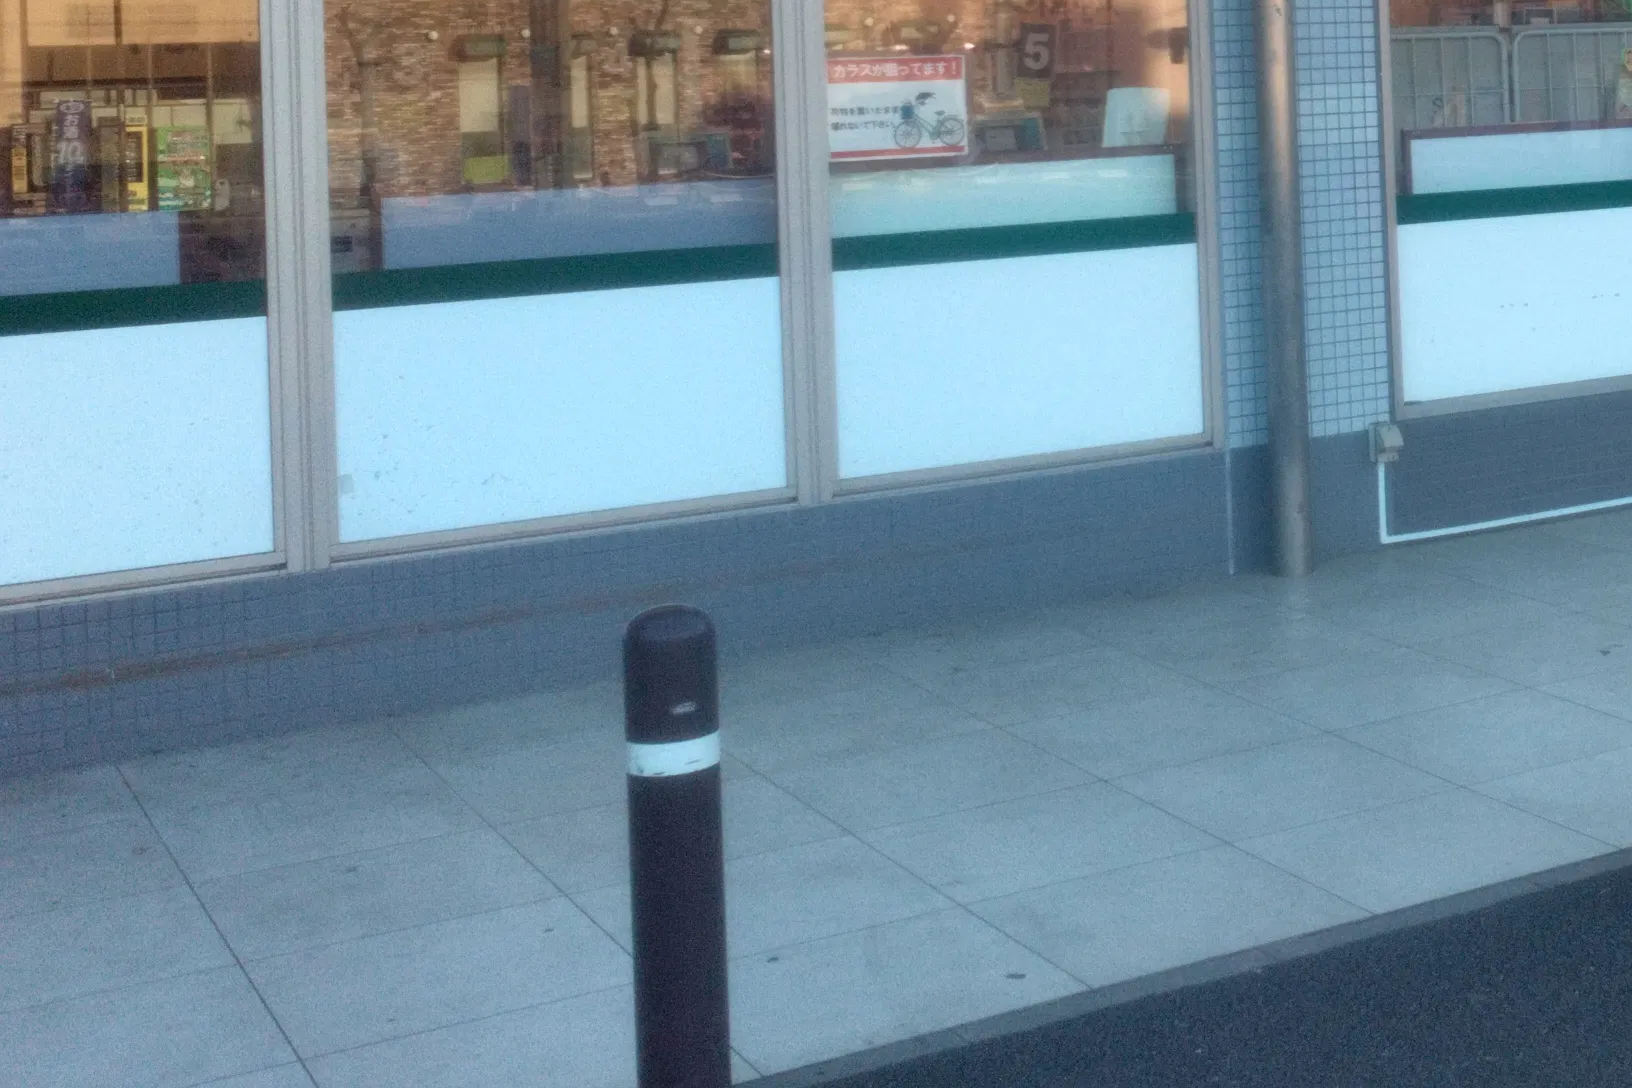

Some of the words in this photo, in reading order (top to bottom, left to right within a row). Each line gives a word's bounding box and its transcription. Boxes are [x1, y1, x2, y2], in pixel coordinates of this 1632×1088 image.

[1023, 32, 1050, 70] 5
[833, 62, 958, 78] カラスが狙ってます！
